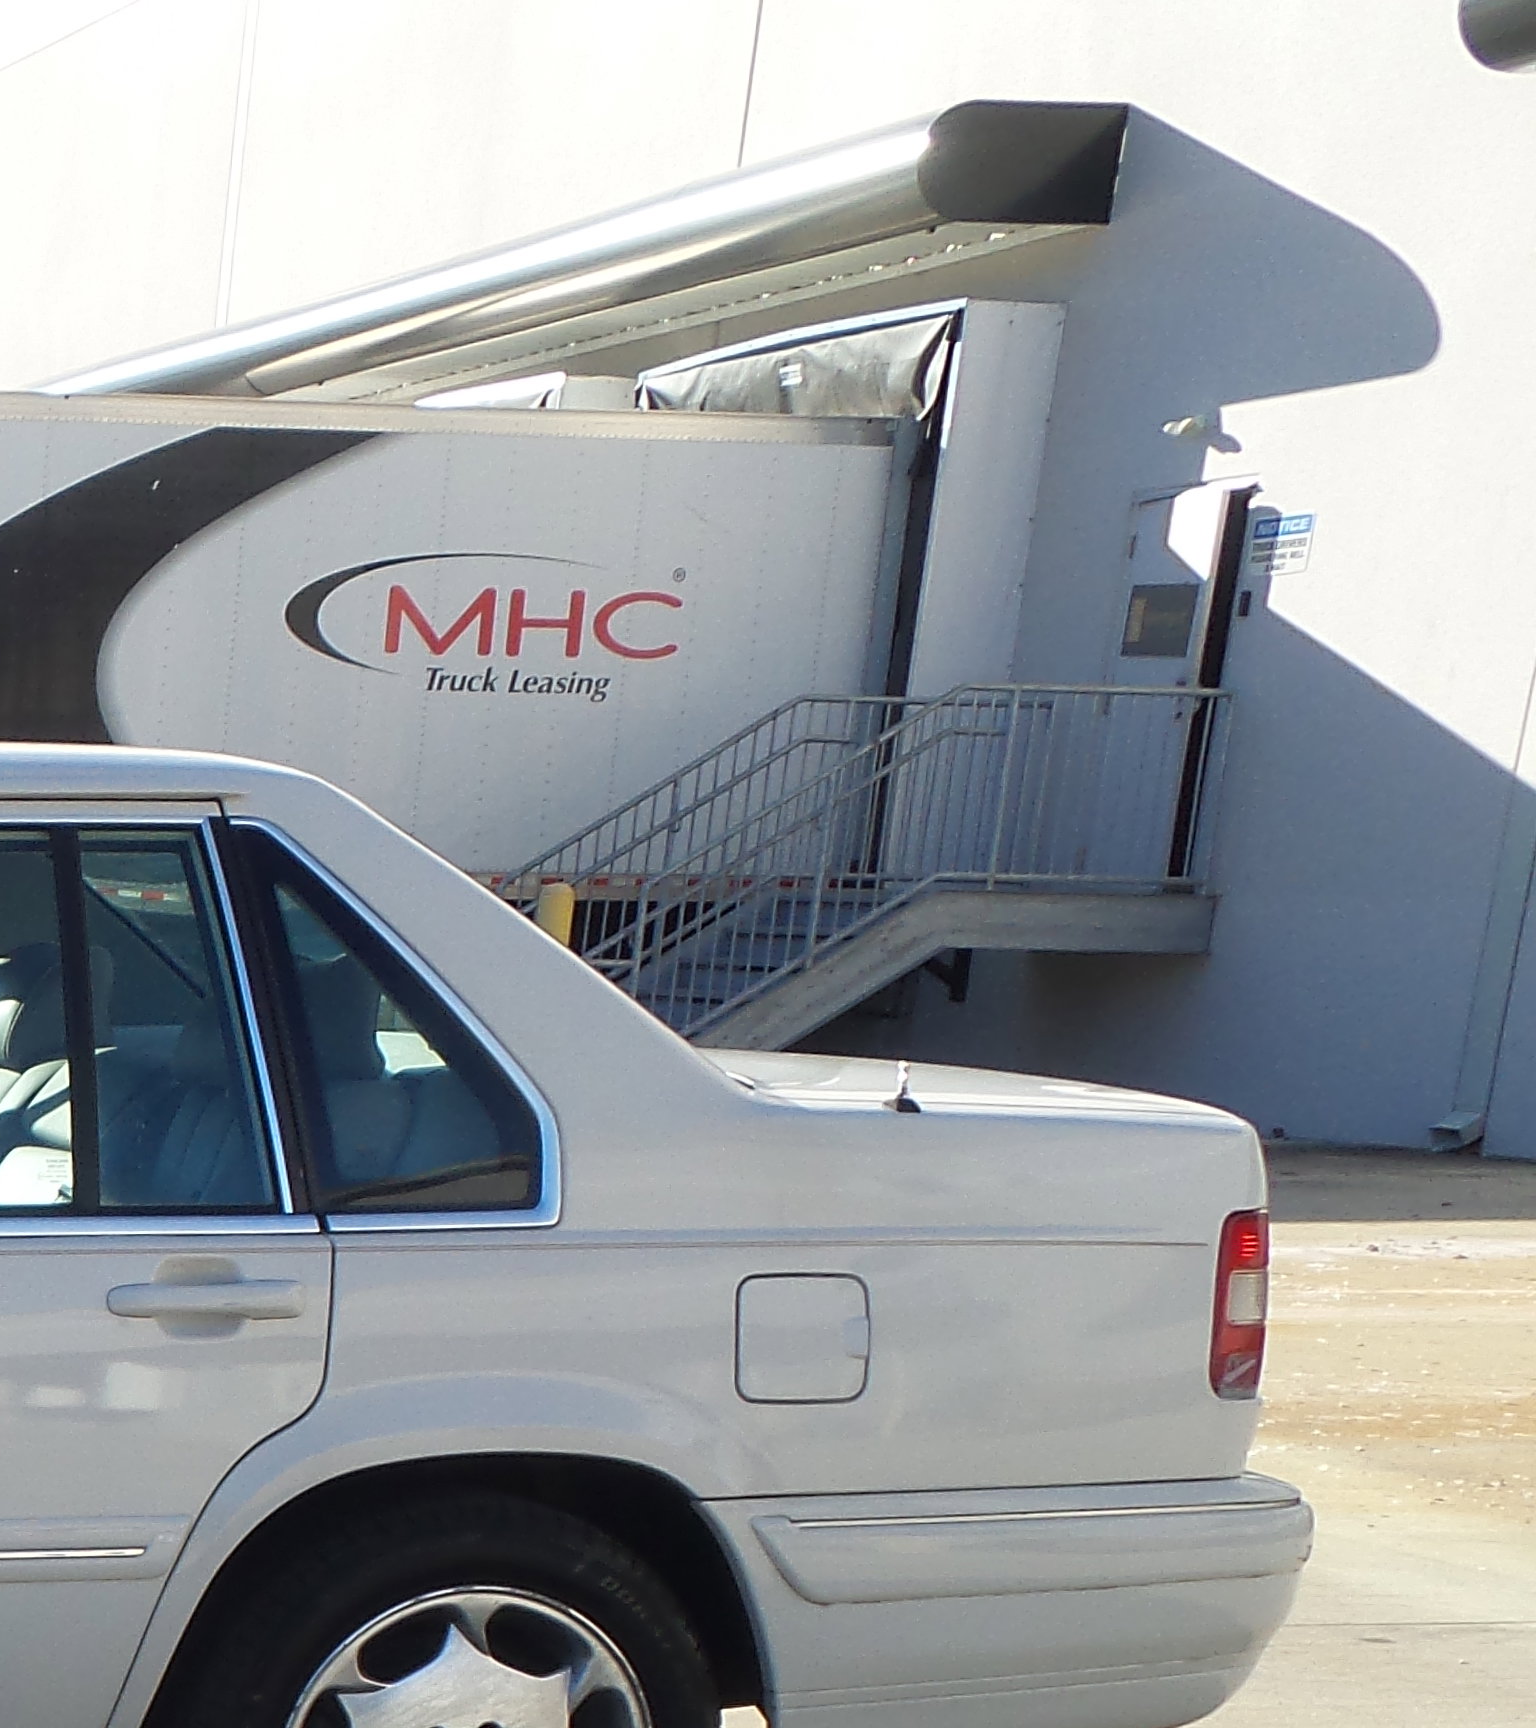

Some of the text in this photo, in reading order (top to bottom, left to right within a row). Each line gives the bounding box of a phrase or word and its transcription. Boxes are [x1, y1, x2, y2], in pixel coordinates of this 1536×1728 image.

[1256, 517, 1310, 536] NOTICE
[383, 584, 684, 661] MHC
[426, 666, 611, 703] Truck Leasing
